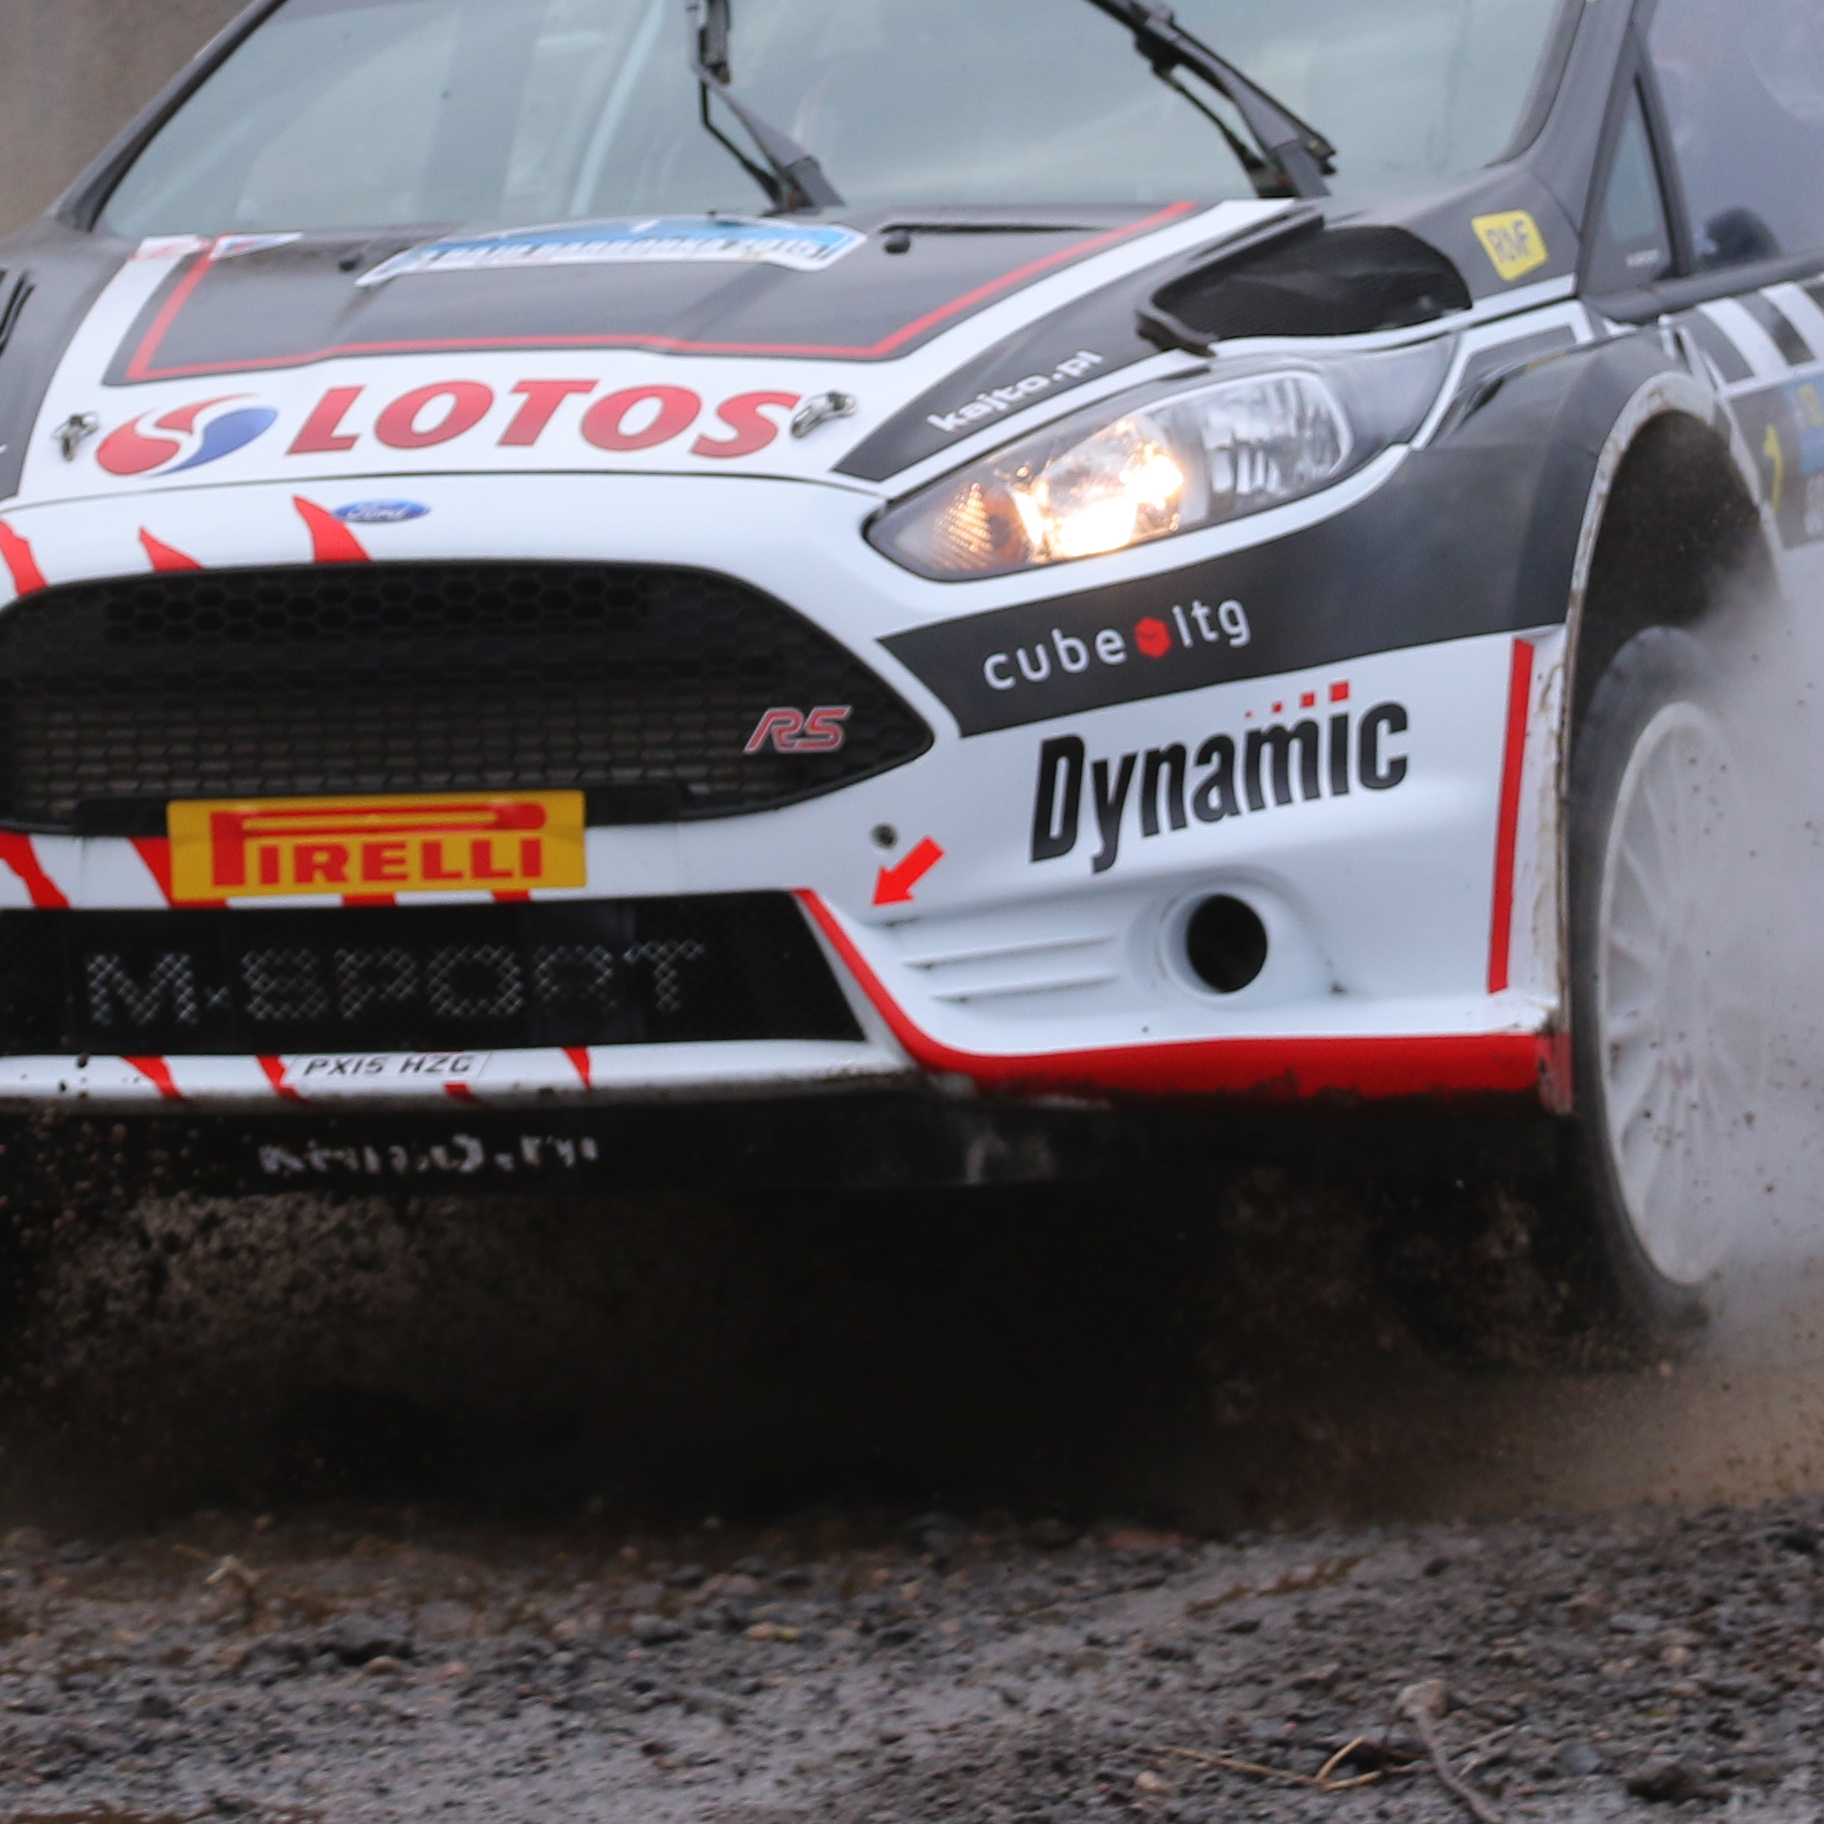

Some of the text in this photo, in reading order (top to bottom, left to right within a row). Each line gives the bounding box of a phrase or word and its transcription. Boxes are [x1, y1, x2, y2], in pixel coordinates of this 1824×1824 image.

[285, 379, 801, 459] LOTOS
[926, 350, 1104, 432] kajto.pl
[982, 598, 1252, 690] cube itg
[1029, 681, 1410, 874] Dynamic
[210, 802, 547, 887] PIRELLI
[303, 1056, 386, 1076] PX15
